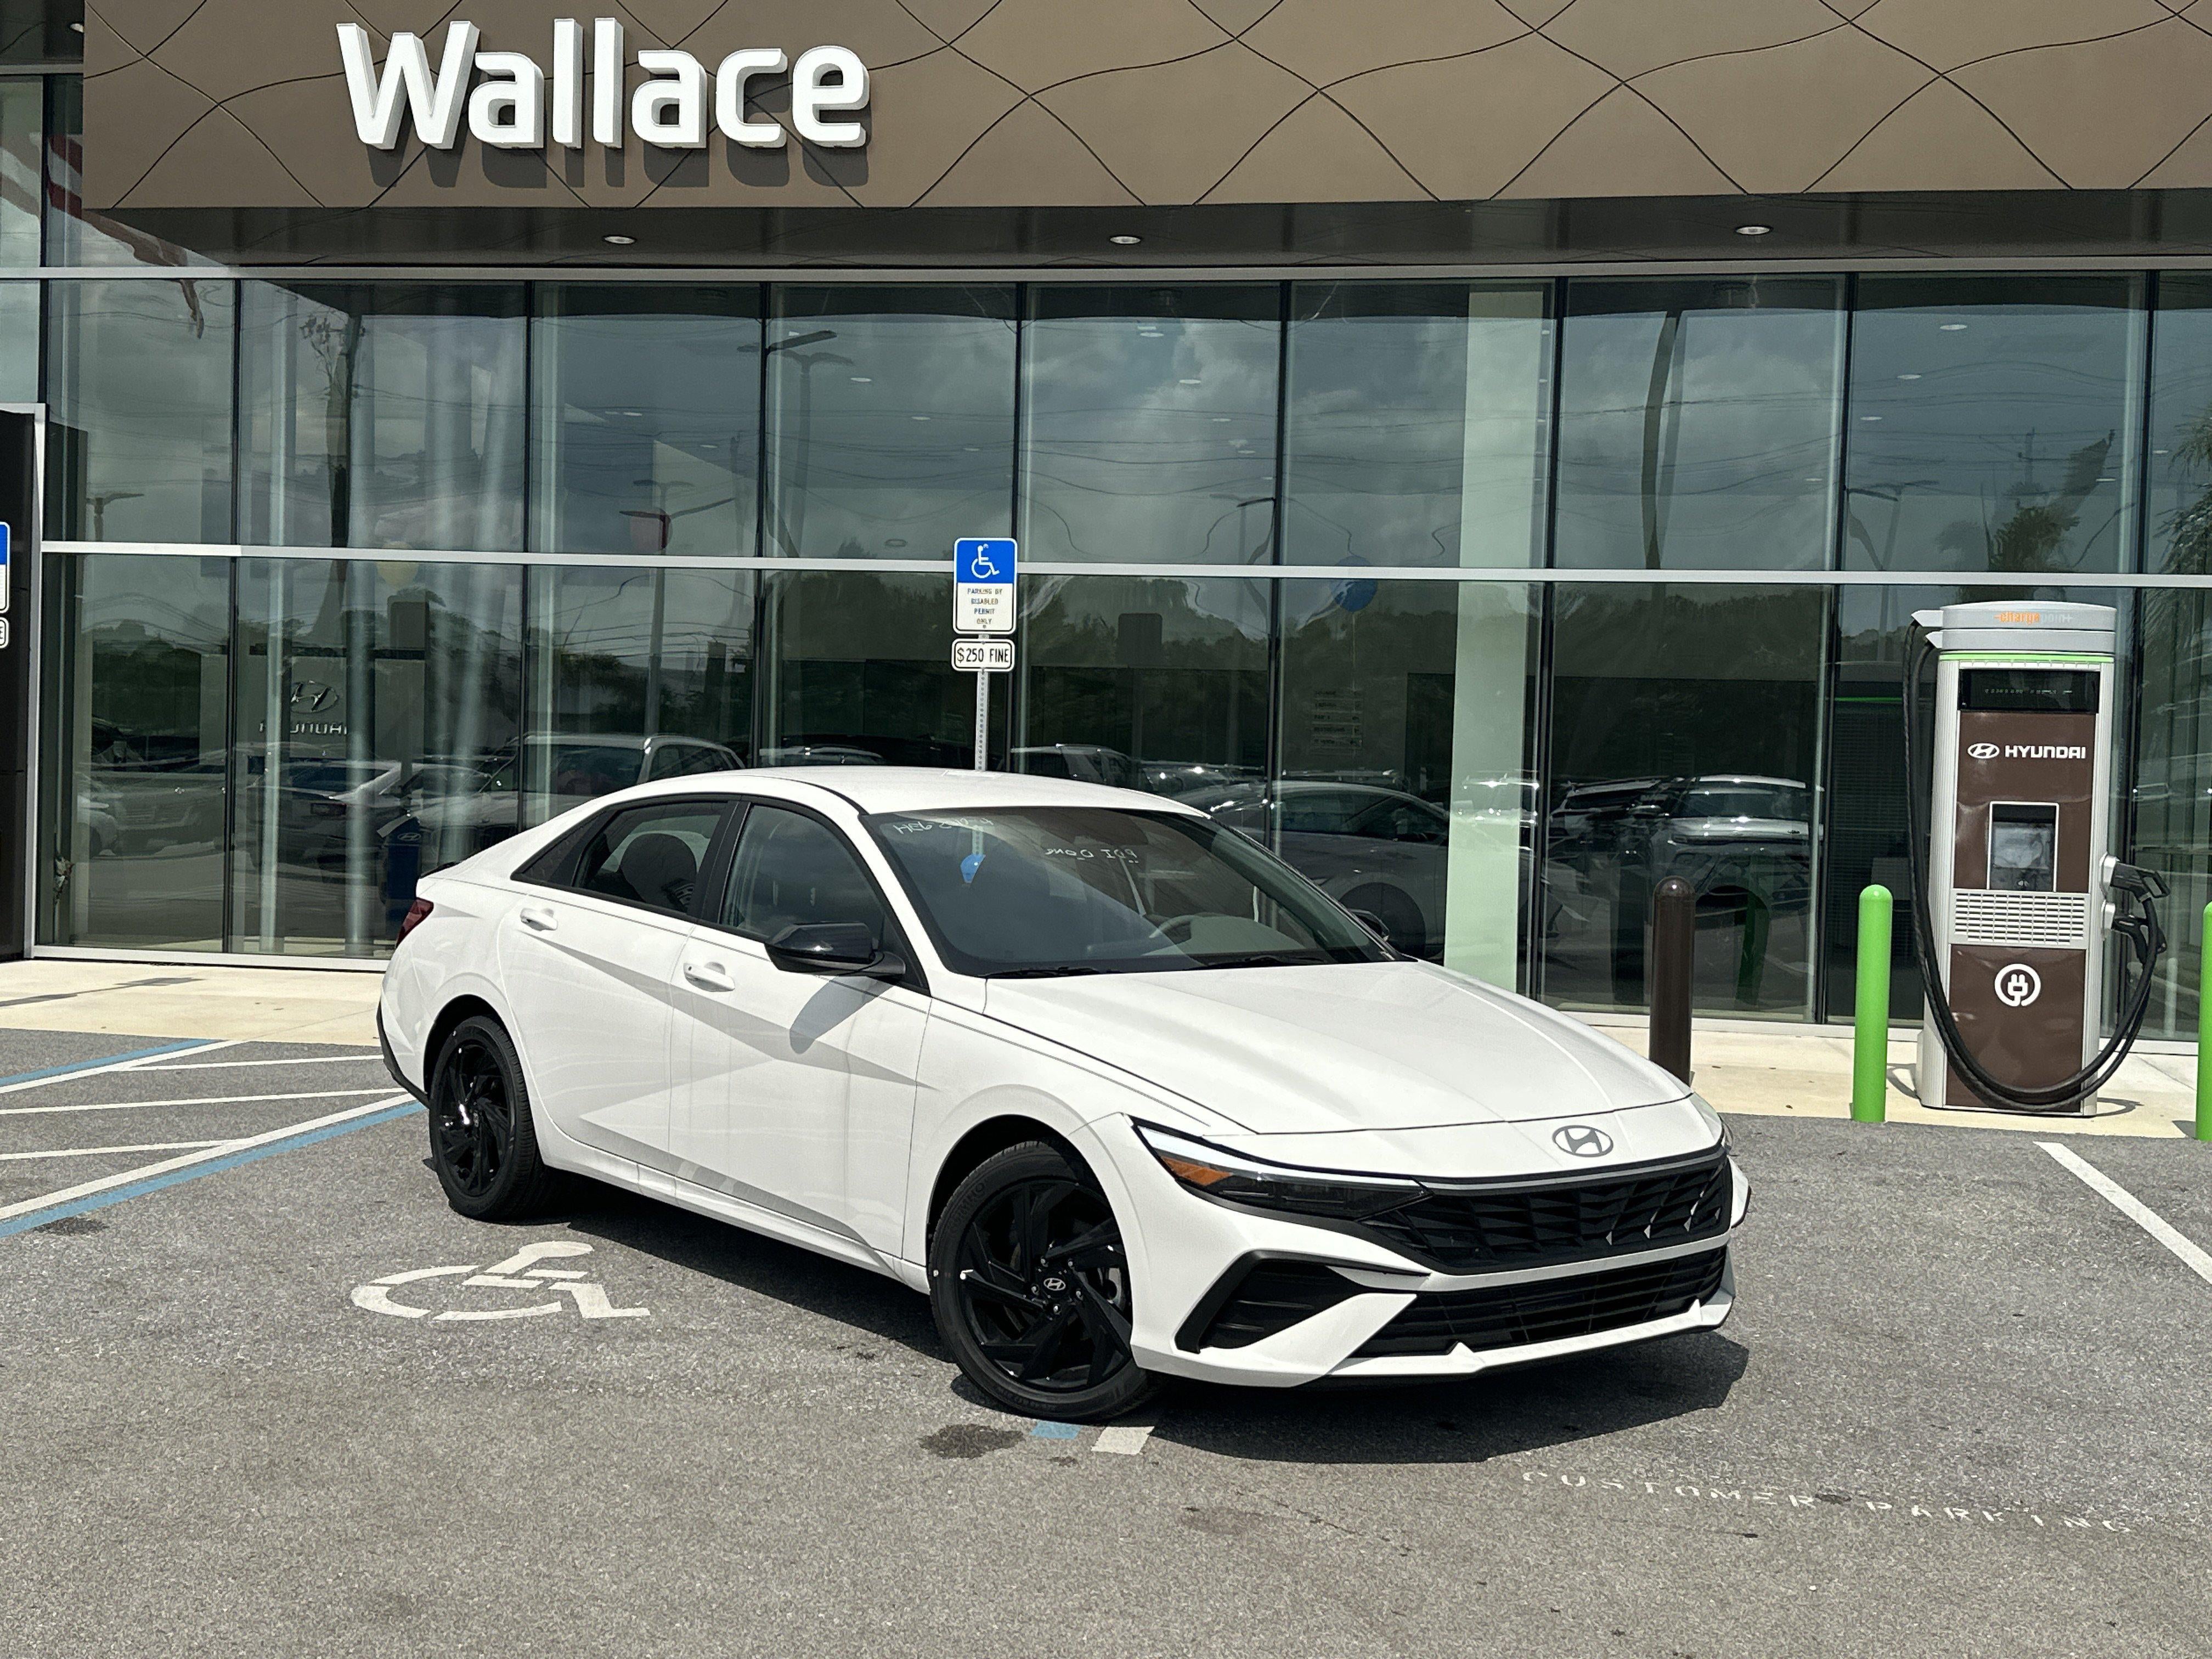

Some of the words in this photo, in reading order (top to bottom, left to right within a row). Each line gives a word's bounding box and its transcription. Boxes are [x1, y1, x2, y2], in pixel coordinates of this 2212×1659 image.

[335, 17, 869, 150] Wallace
[957, 647, 984, 663] $250
[989, 648, 1009, 663] FINE
[2006, 746, 2086, 759] HYUNDAI
